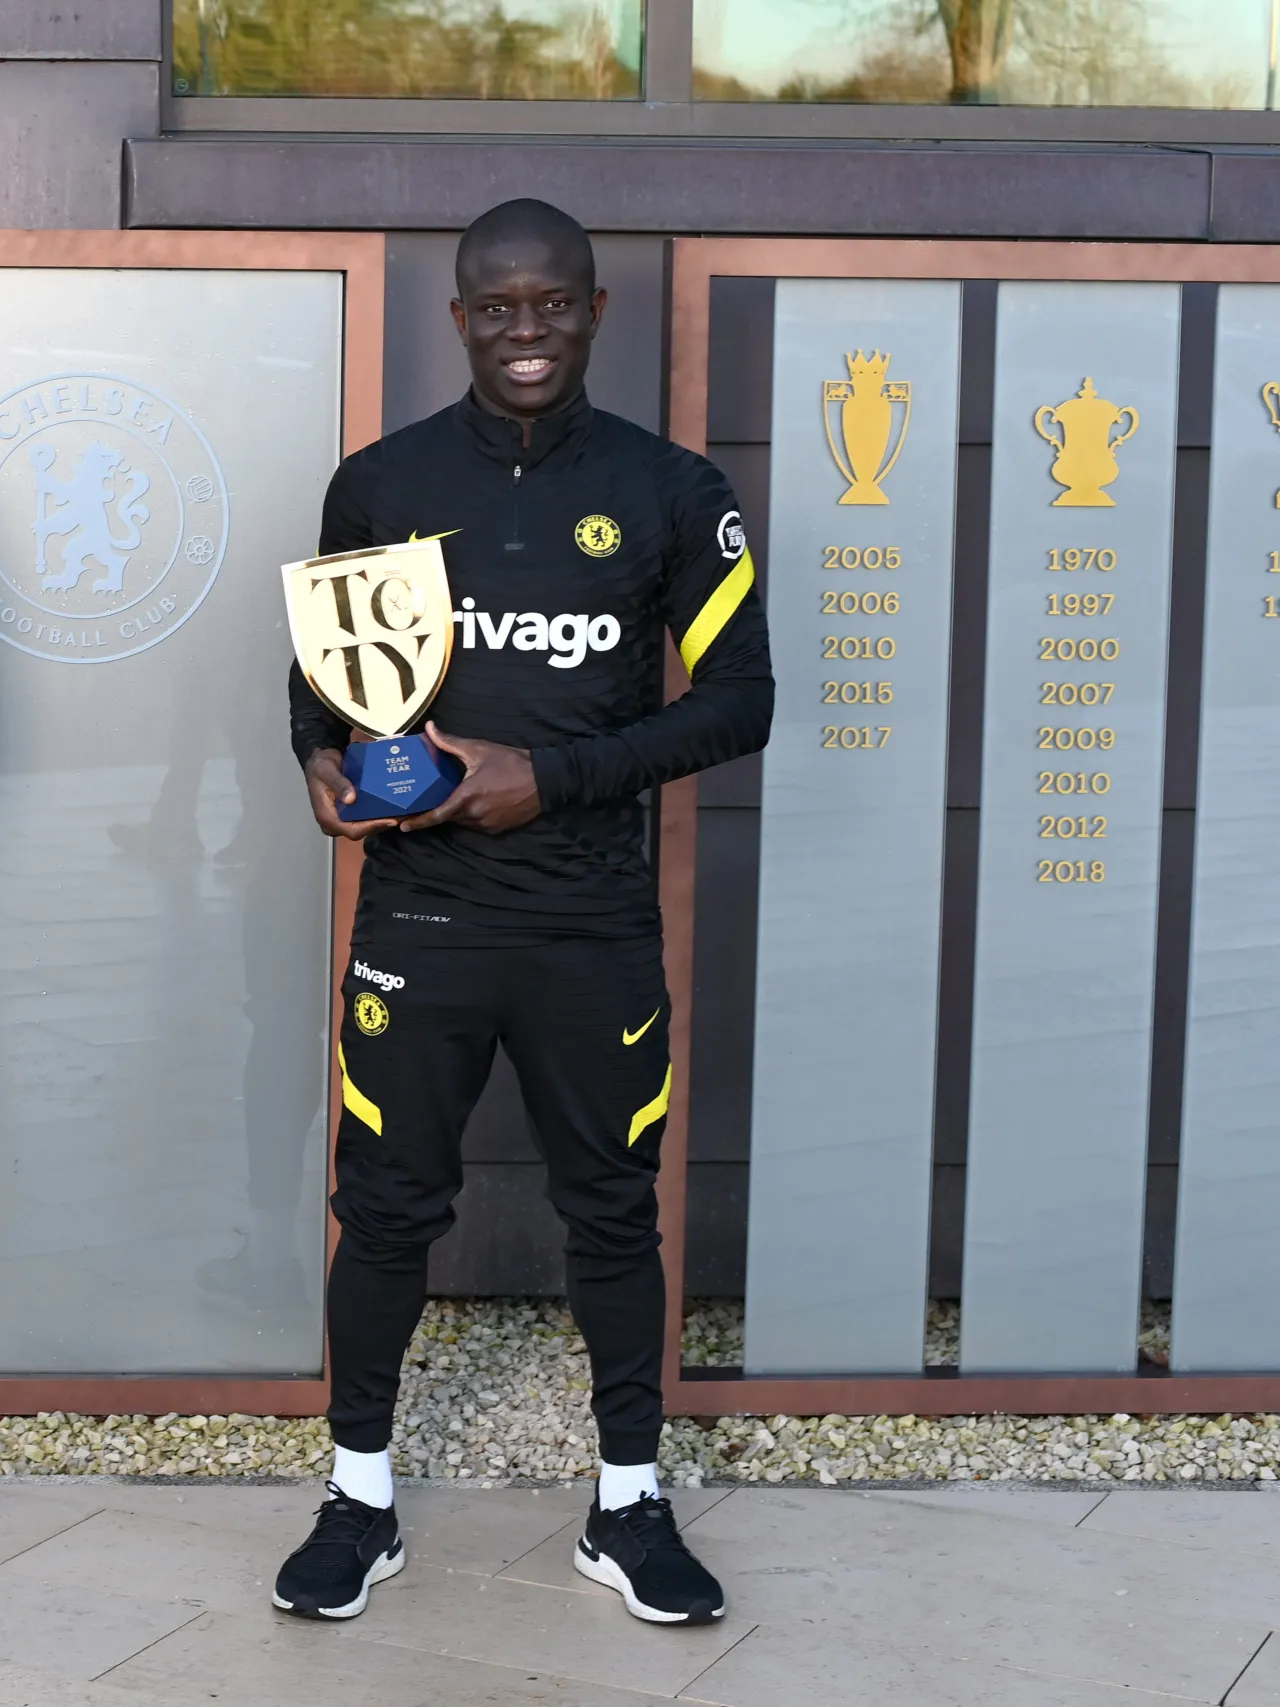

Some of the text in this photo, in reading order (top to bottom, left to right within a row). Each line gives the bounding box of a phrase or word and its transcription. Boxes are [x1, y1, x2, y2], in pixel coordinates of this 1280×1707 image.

[824, 547, 902, 569] 2005
[1048, 549, 1117, 571] 1970
[823, 592, 900, 614] 2006
[1047, 594, 1116, 616] 1997
[119, 597, 177, 639] CLUB
[824, 637, 896, 659] 2010
[1040, 638, 1120, 661] 2000
[824, 682, 893, 704] 2015
[1042, 682, 1115, 705] 2007
[824, 726, 892, 748] 2017
[1039, 728, 1115, 750] 2009
[385, 756, 409, 765] TEAM
[386, 764, 410, 773] YEAR
[392, 786, 412, 795] 2021
[1039, 772, 1111, 795] 2010
[1040, 816, 1108, 838] 2012
[1039, 861, 1106, 883] 2018
[354, 960, 405, 991] trivago
